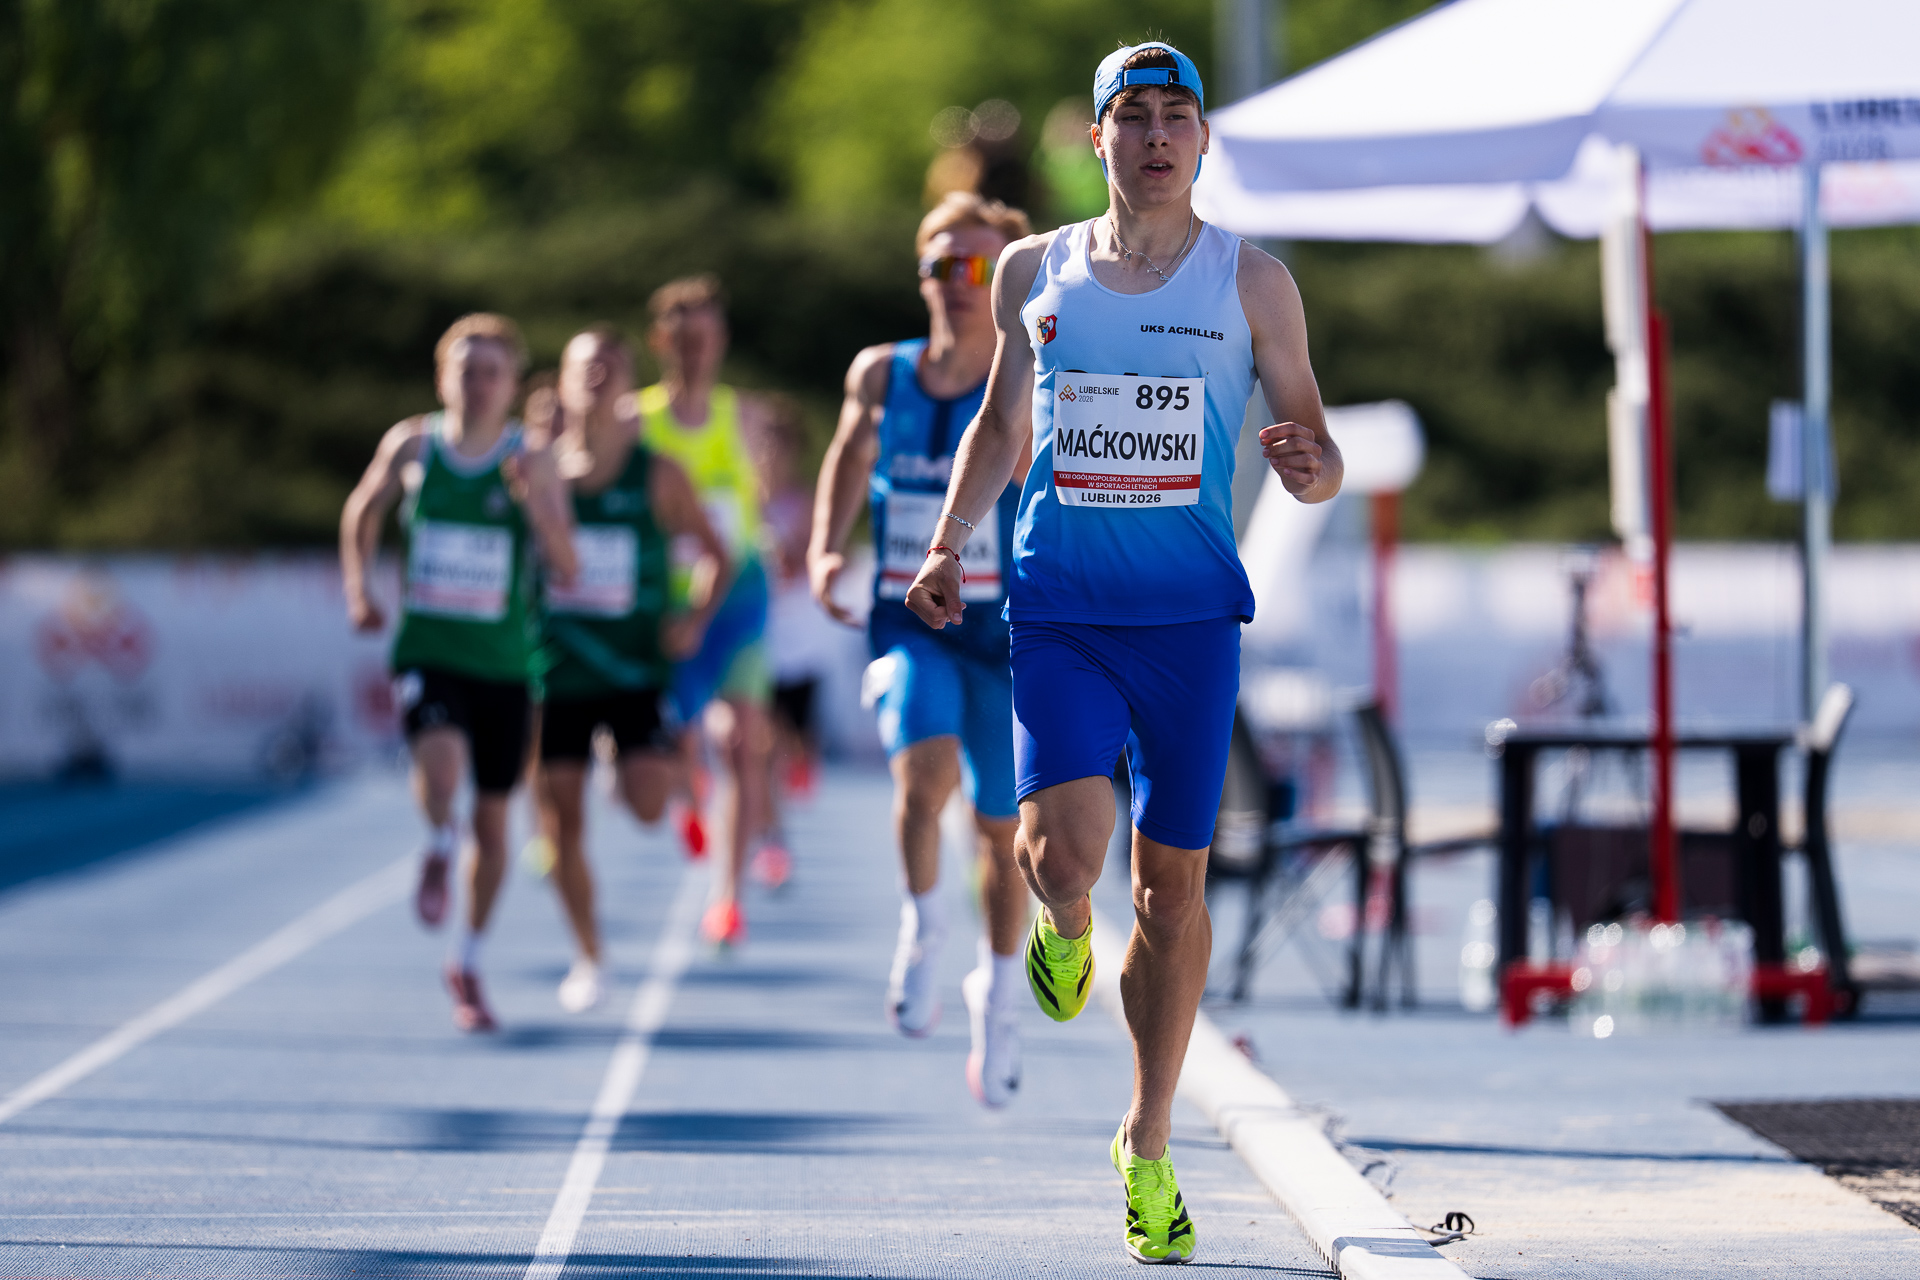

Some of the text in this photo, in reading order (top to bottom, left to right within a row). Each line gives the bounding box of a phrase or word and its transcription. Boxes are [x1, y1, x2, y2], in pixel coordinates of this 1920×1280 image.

[1140, 324, 1224, 341] UKS ACHILLES
[1079, 385, 1120, 396] LUBELSKIE
[1078, 395, 1094, 403] 2026
[1135, 384, 1190, 411] 895
[1057, 424, 1197, 461] MAĆKOWSKI
[1072, 473, 1122, 482] OGÓLNOPOLSKA
[1123, 476, 1158, 484] OLIMPIADA
[1158, 475, 1193, 483] MŁODZIEŻY
[1095, 482, 1131, 490] SPORTACH
[1081, 492, 1161, 504] LUBLIN 2026
